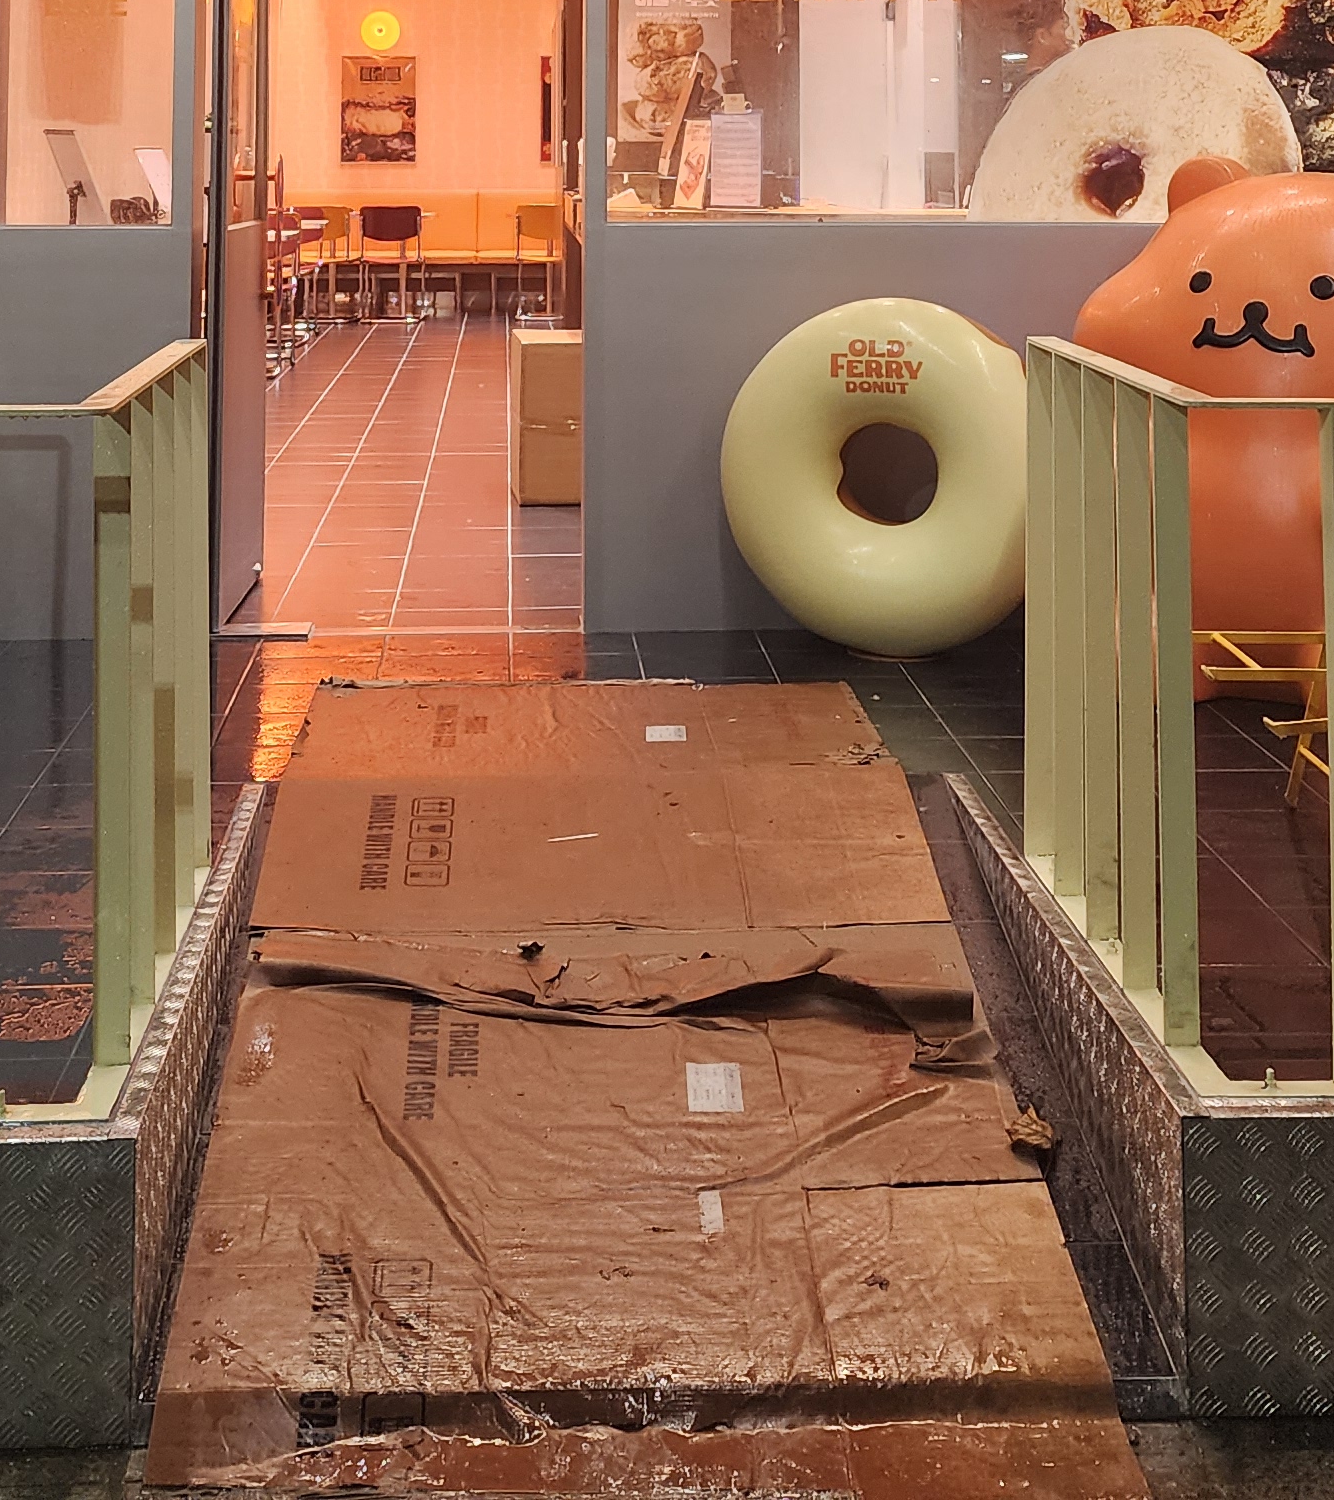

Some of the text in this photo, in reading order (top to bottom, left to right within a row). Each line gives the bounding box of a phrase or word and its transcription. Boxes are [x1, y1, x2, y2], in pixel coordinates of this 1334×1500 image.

[831, 353, 923, 380] FERRY
[848, 339, 905, 358] OLD
[846, 381, 909, 394] DONUT
[359, 794, 397, 890] HANDLE WITH CARE
[406, 1040, 438, 1076] WITH
[448, 1023, 479, 1077] FRAGILE
[403, 1081, 436, 1121] CARE
